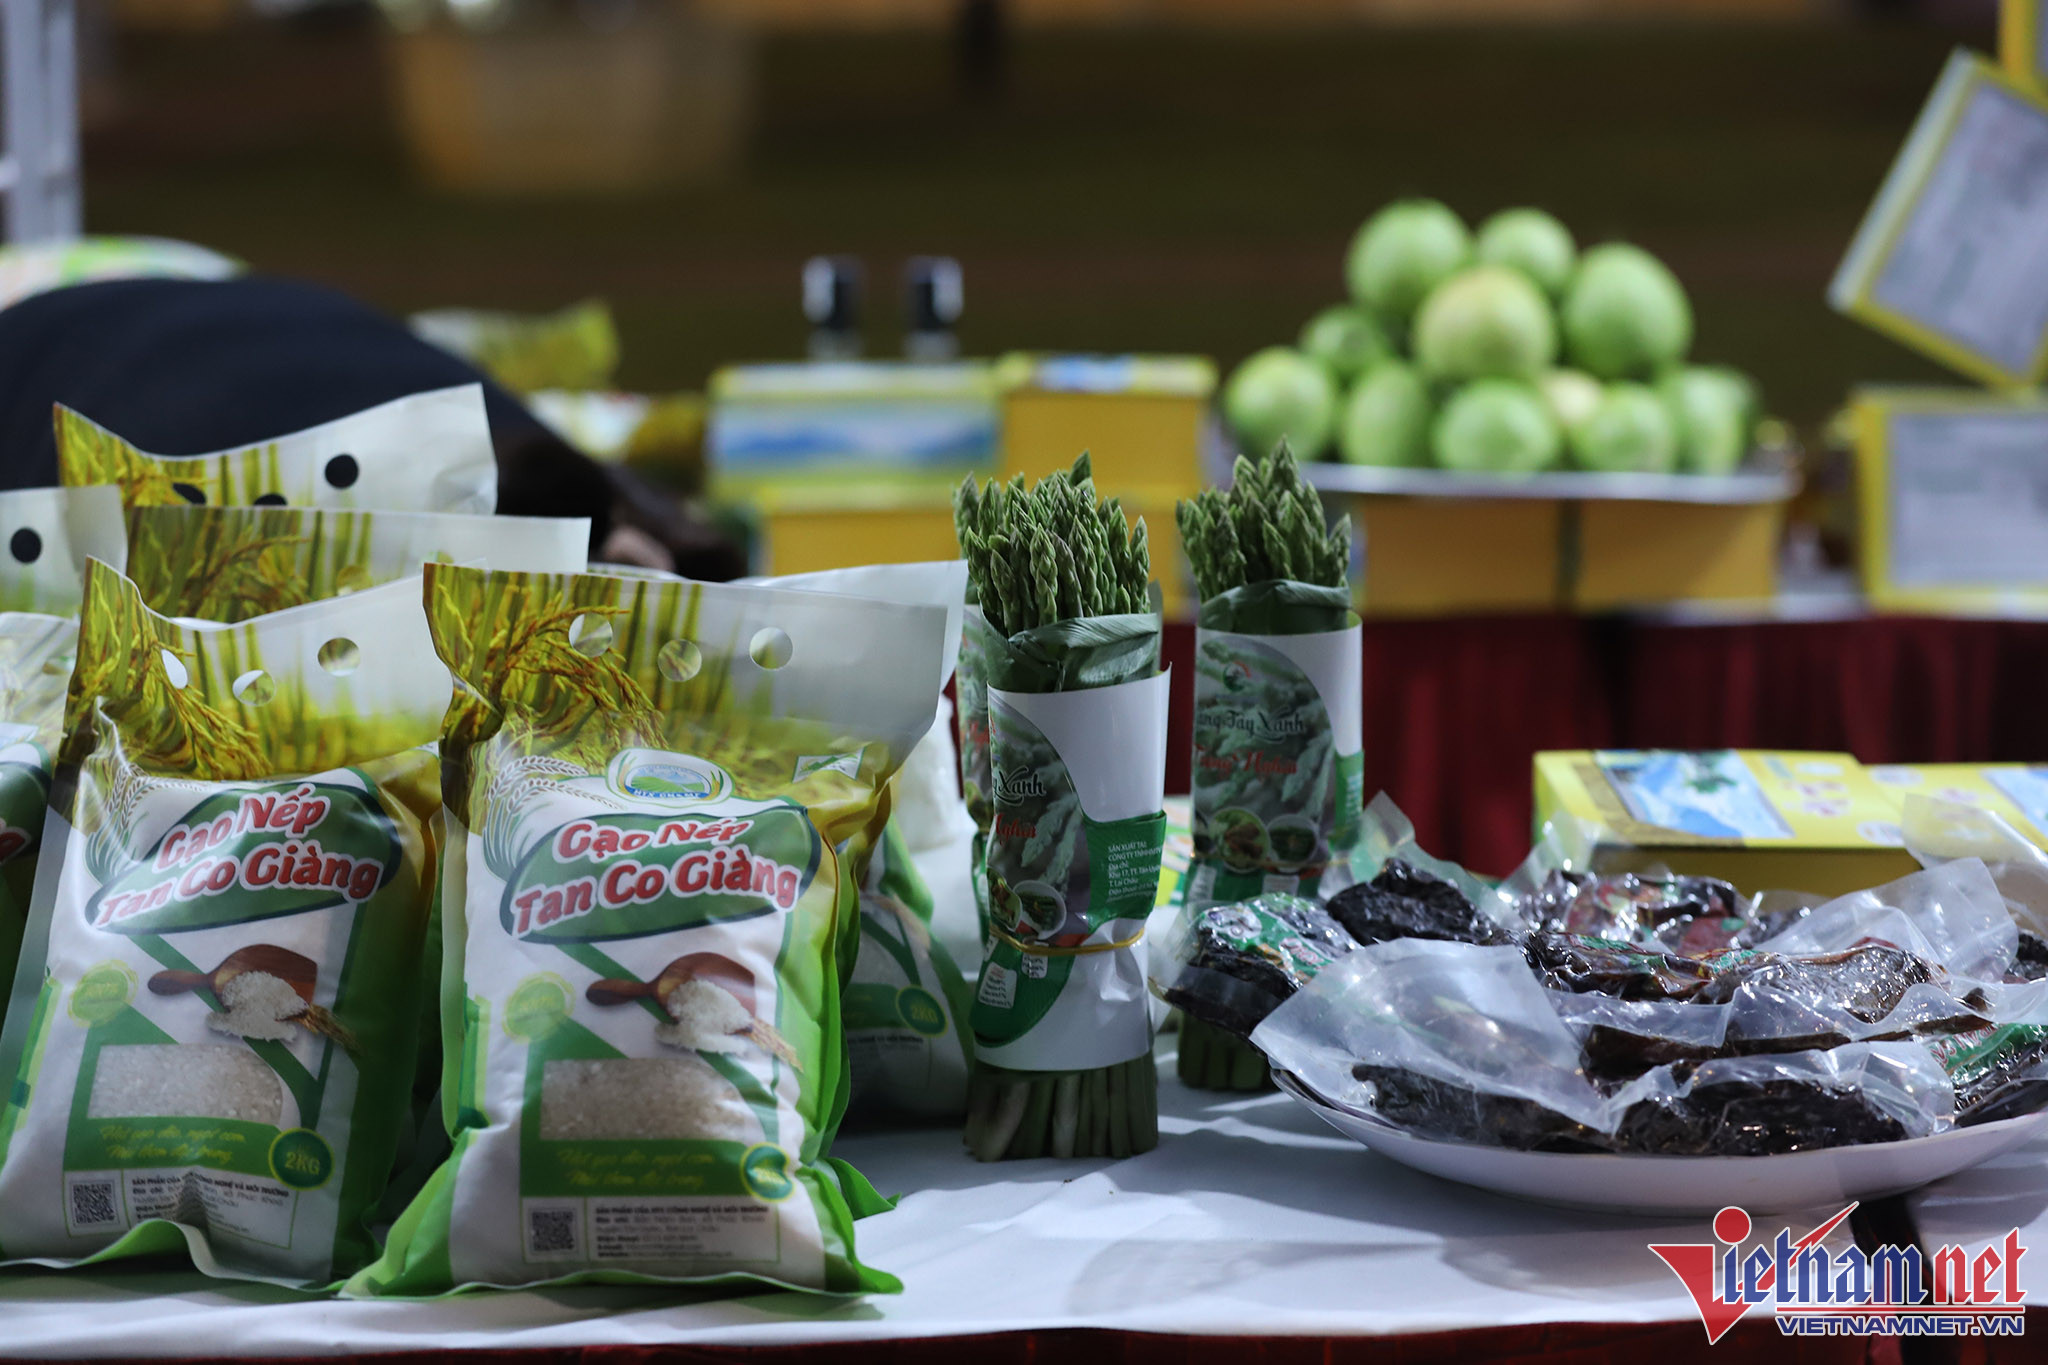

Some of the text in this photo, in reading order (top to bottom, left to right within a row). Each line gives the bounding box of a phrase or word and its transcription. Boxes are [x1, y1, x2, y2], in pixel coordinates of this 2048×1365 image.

[1255, 706, 1304, 742] Xanh
[996, 766, 1046, 805] Xanh
[158, 785, 329, 868] Gạo Nếp
[557, 818, 751, 860] Gạo Nếp
[98, 840, 380, 926] Tan Co Giàng
[515, 849, 798, 933] Tan Co Giàng
[285, 1150, 322, 1176] 2KG
